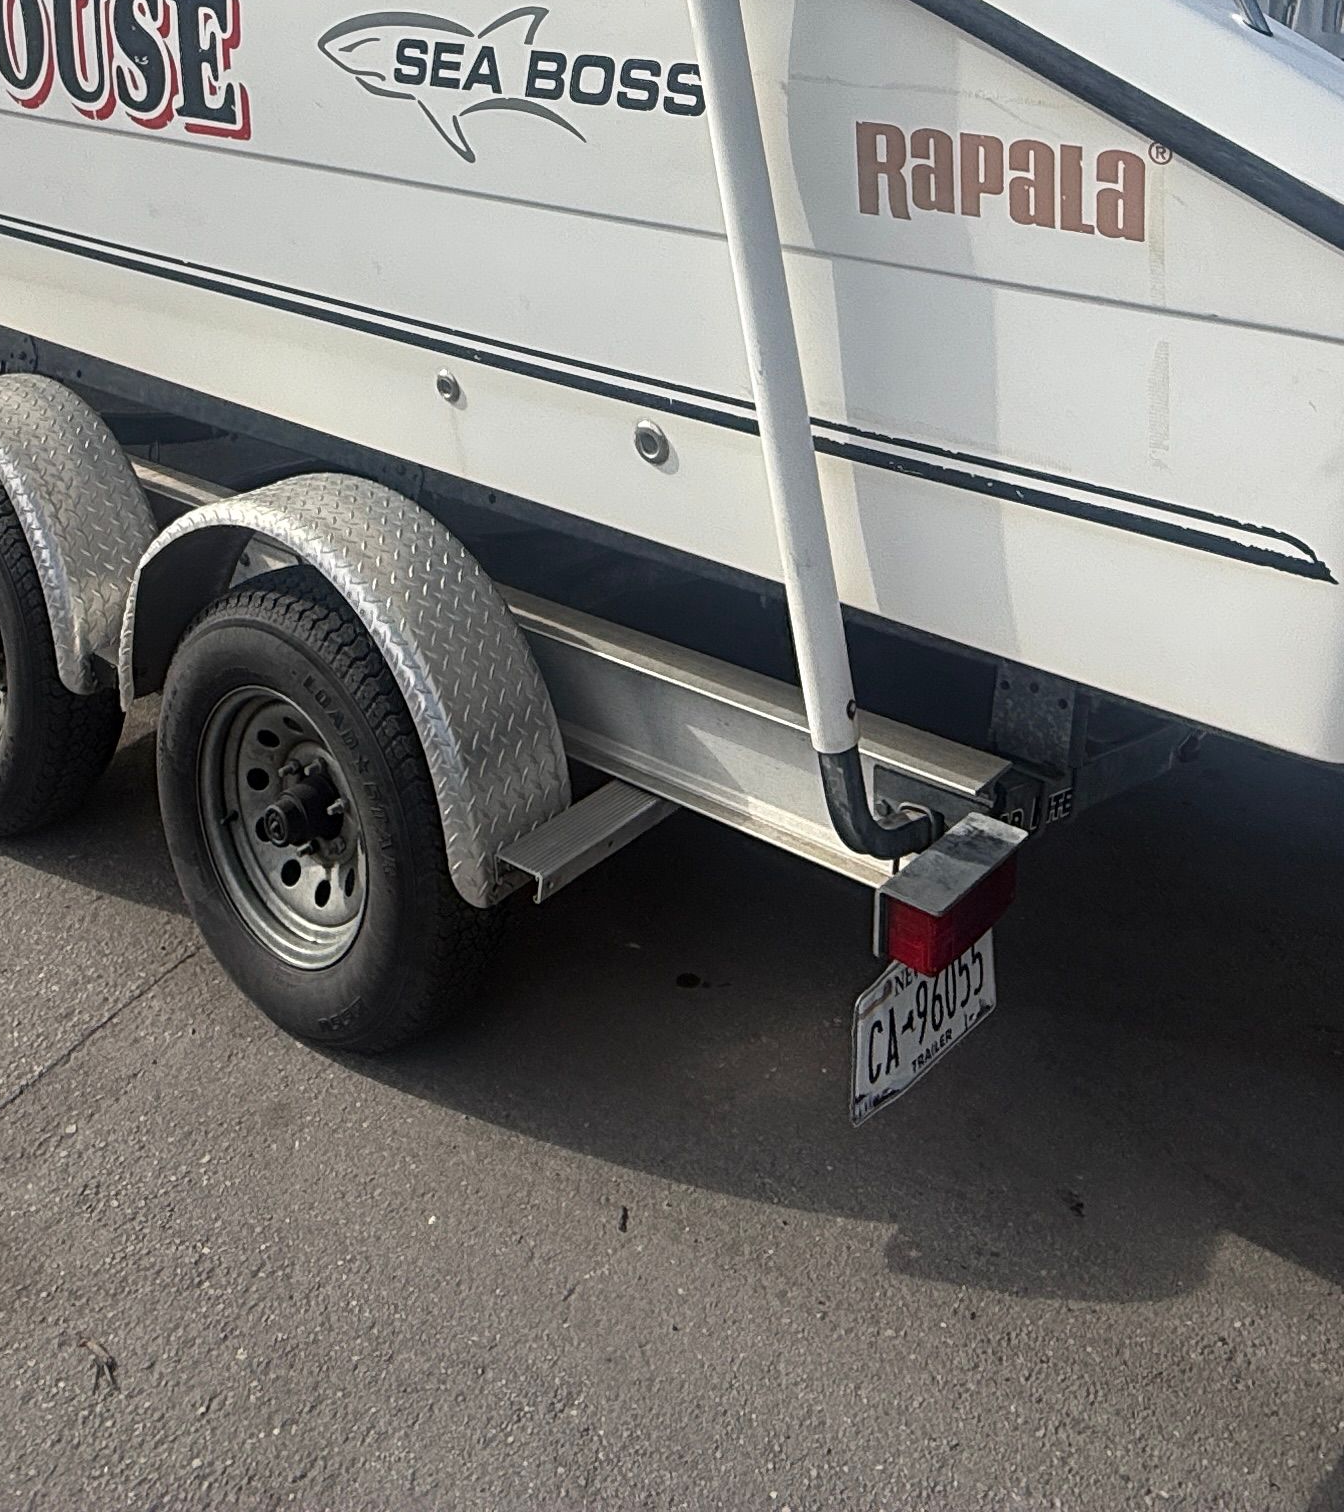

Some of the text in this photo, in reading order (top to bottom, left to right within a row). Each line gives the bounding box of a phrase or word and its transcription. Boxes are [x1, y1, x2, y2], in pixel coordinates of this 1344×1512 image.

[393, 38, 708, 118] SEA BOSS
[911, 1028, 953, 1074] TRAILER
